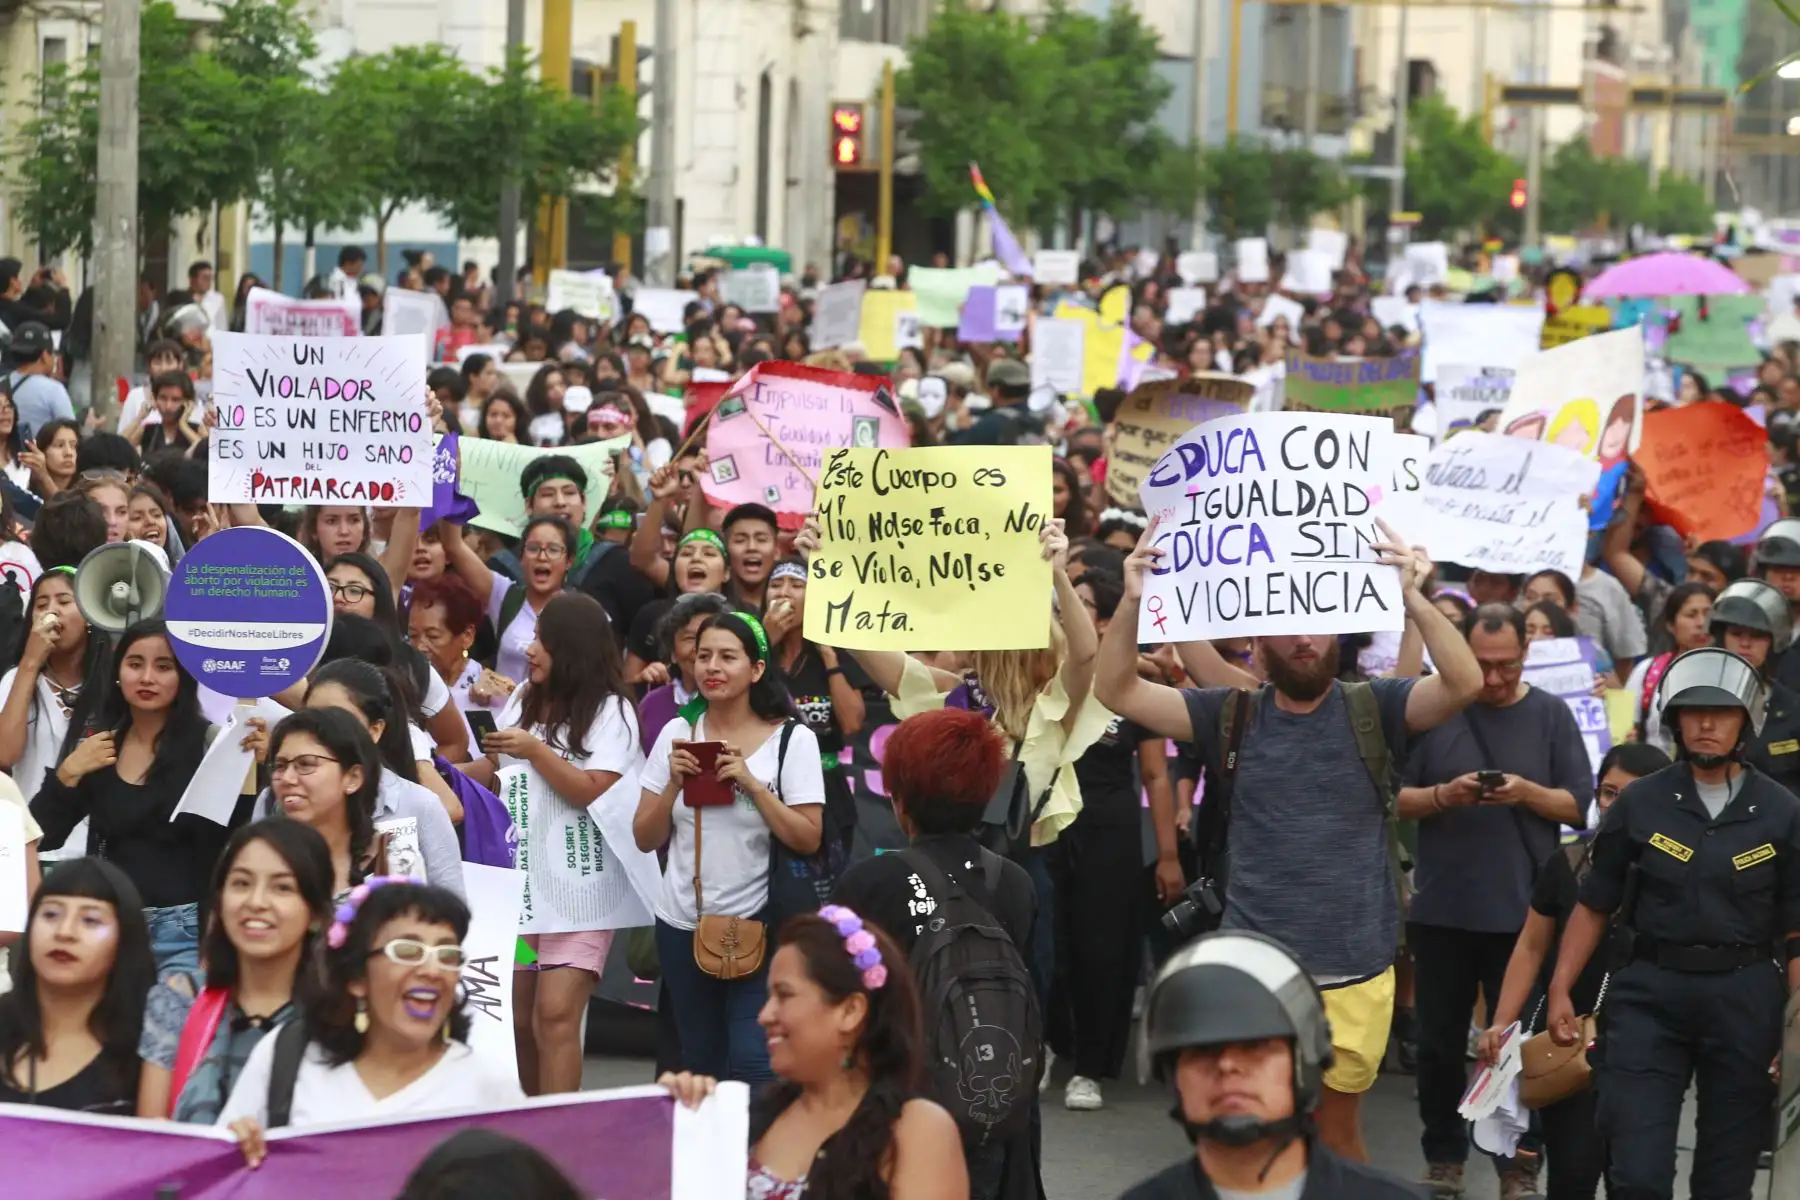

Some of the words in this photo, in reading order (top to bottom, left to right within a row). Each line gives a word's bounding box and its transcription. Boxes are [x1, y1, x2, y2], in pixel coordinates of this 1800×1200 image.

[294, 343, 324, 365] UN
[246, 368, 376, 402] VIOLADOR
[216, 404, 245, 428] NO
[254, 406, 277, 428] ES
[287, 407, 316, 430] UN
[330, 408, 422, 433] ENFERMO
[218, 439, 244, 459] ES
[257, 440, 286, 460] UN
[302, 442, 349, 461] HIJO
[365, 444, 413, 464] SANO
[1149, 427, 1266, 488] EDUCA
[1280, 425, 1370, 472] CON
[251, 472, 394, 501] PATRIARCADO
[823, 449, 864, 489] Este
[872, 449, 957, 496] Cuerpo
[973, 467, 1007, 488] es
[1181, 479, 1370, 526] IGUALDAD
[1149, 522, 1275, 575] EDUCA
[1291, 521, 1382, 560] SIN
[184, 575, 220, 585] aborto
[223, 577, 242, 587] por
[244, 575, 293, 587] violación
[295, 578, 308, 587] es
[185, 564, 198, 574] La
[201, 563, 286, 576] despenalización
[288, 565, 306, 576] del
[812, 558, 844, 580] se
[852, 551, 921, 589] Viola,
[190, 587, 205, 596] un
[207, 586, 251, 597] derecho
[254, 586, 302, 598] humano.
[1175, 570, 1388, 625] VIOLENCIA
[825, 589, 915, 634] Mata.
[188, 628, 304, 640] #DecidirNosHaceLibres
[216, 660, 247, 670] SAAF
[565, 824, 577, 869] SOLSIRET
[577, 815, 590, 863] SEGUIMOS
[581, 865, 591, 877] TE
[461, 955, 503, 1022] AMA
